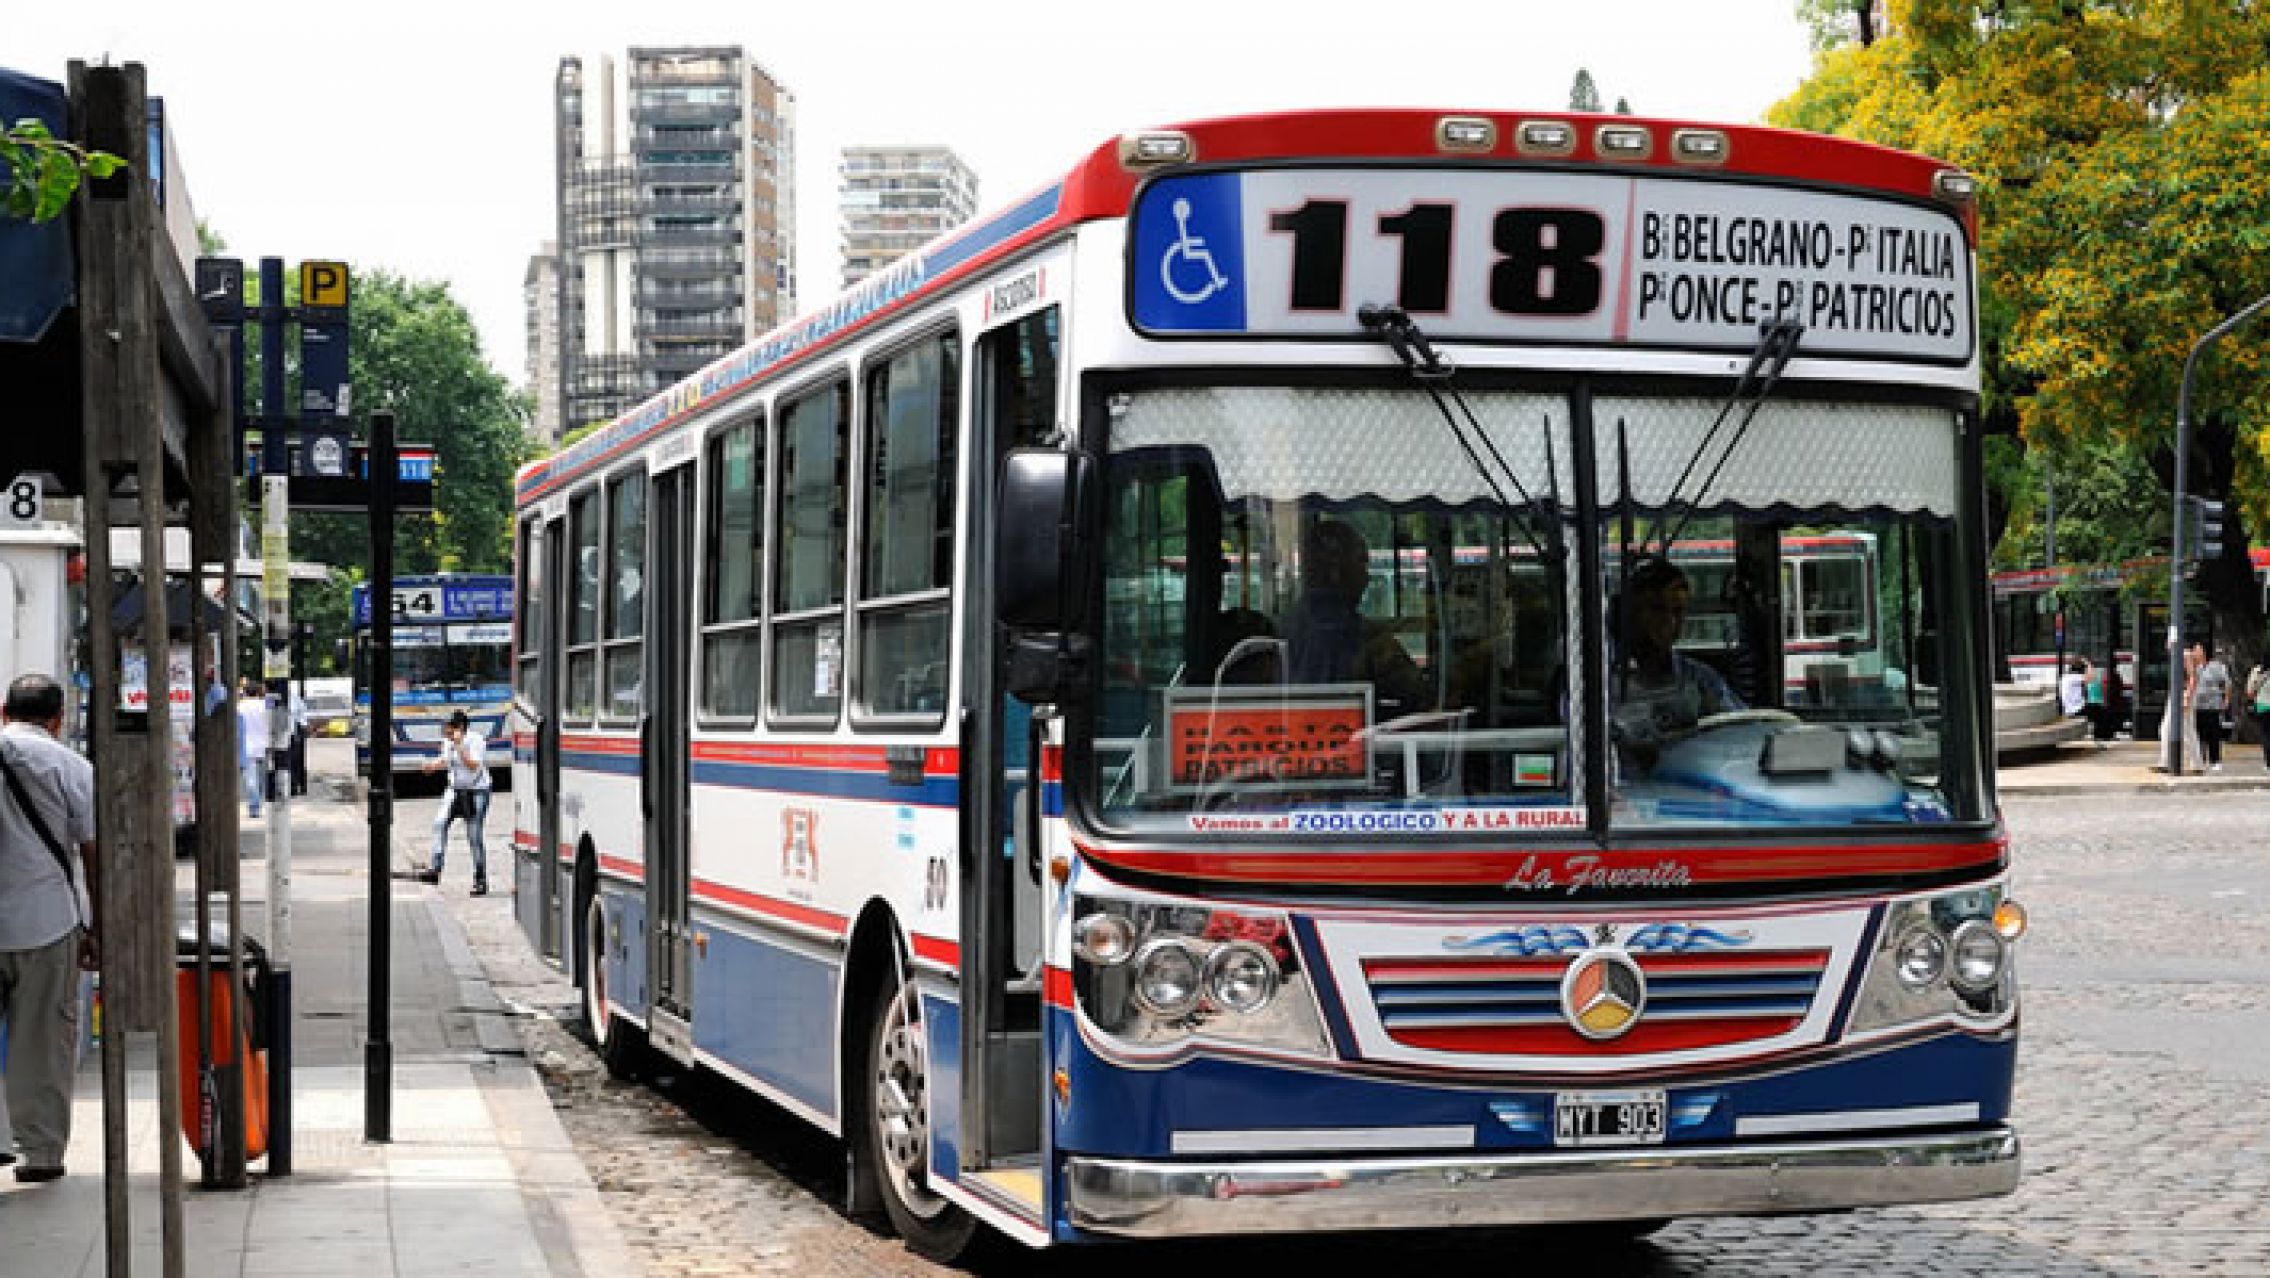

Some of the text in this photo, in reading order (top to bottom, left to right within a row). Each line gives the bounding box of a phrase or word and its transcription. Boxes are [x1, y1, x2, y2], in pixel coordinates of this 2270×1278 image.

[1267, 198, 1608, 318] 118
[1877, 227, 1955, 281] ITALIA
[312, 268, 337, 301] P
[1810, 281, 1955, 338] PATRICIOS
[11, 481, 36, 520] 8
[1191, 816, 1263, 831] Vamos
[1294, 813, 1437, 831] ZOOLOGICO
[1443, 811, 1456, 828] Y
[1463, 811, 1478, 828] A
[1484, 810, 1510, 828] LA
[1516, 809, 1584, 827] RURAL
[1503, 855, 1692, 895] La Favorita
[1617, 1102, 1662, 1134] 903
